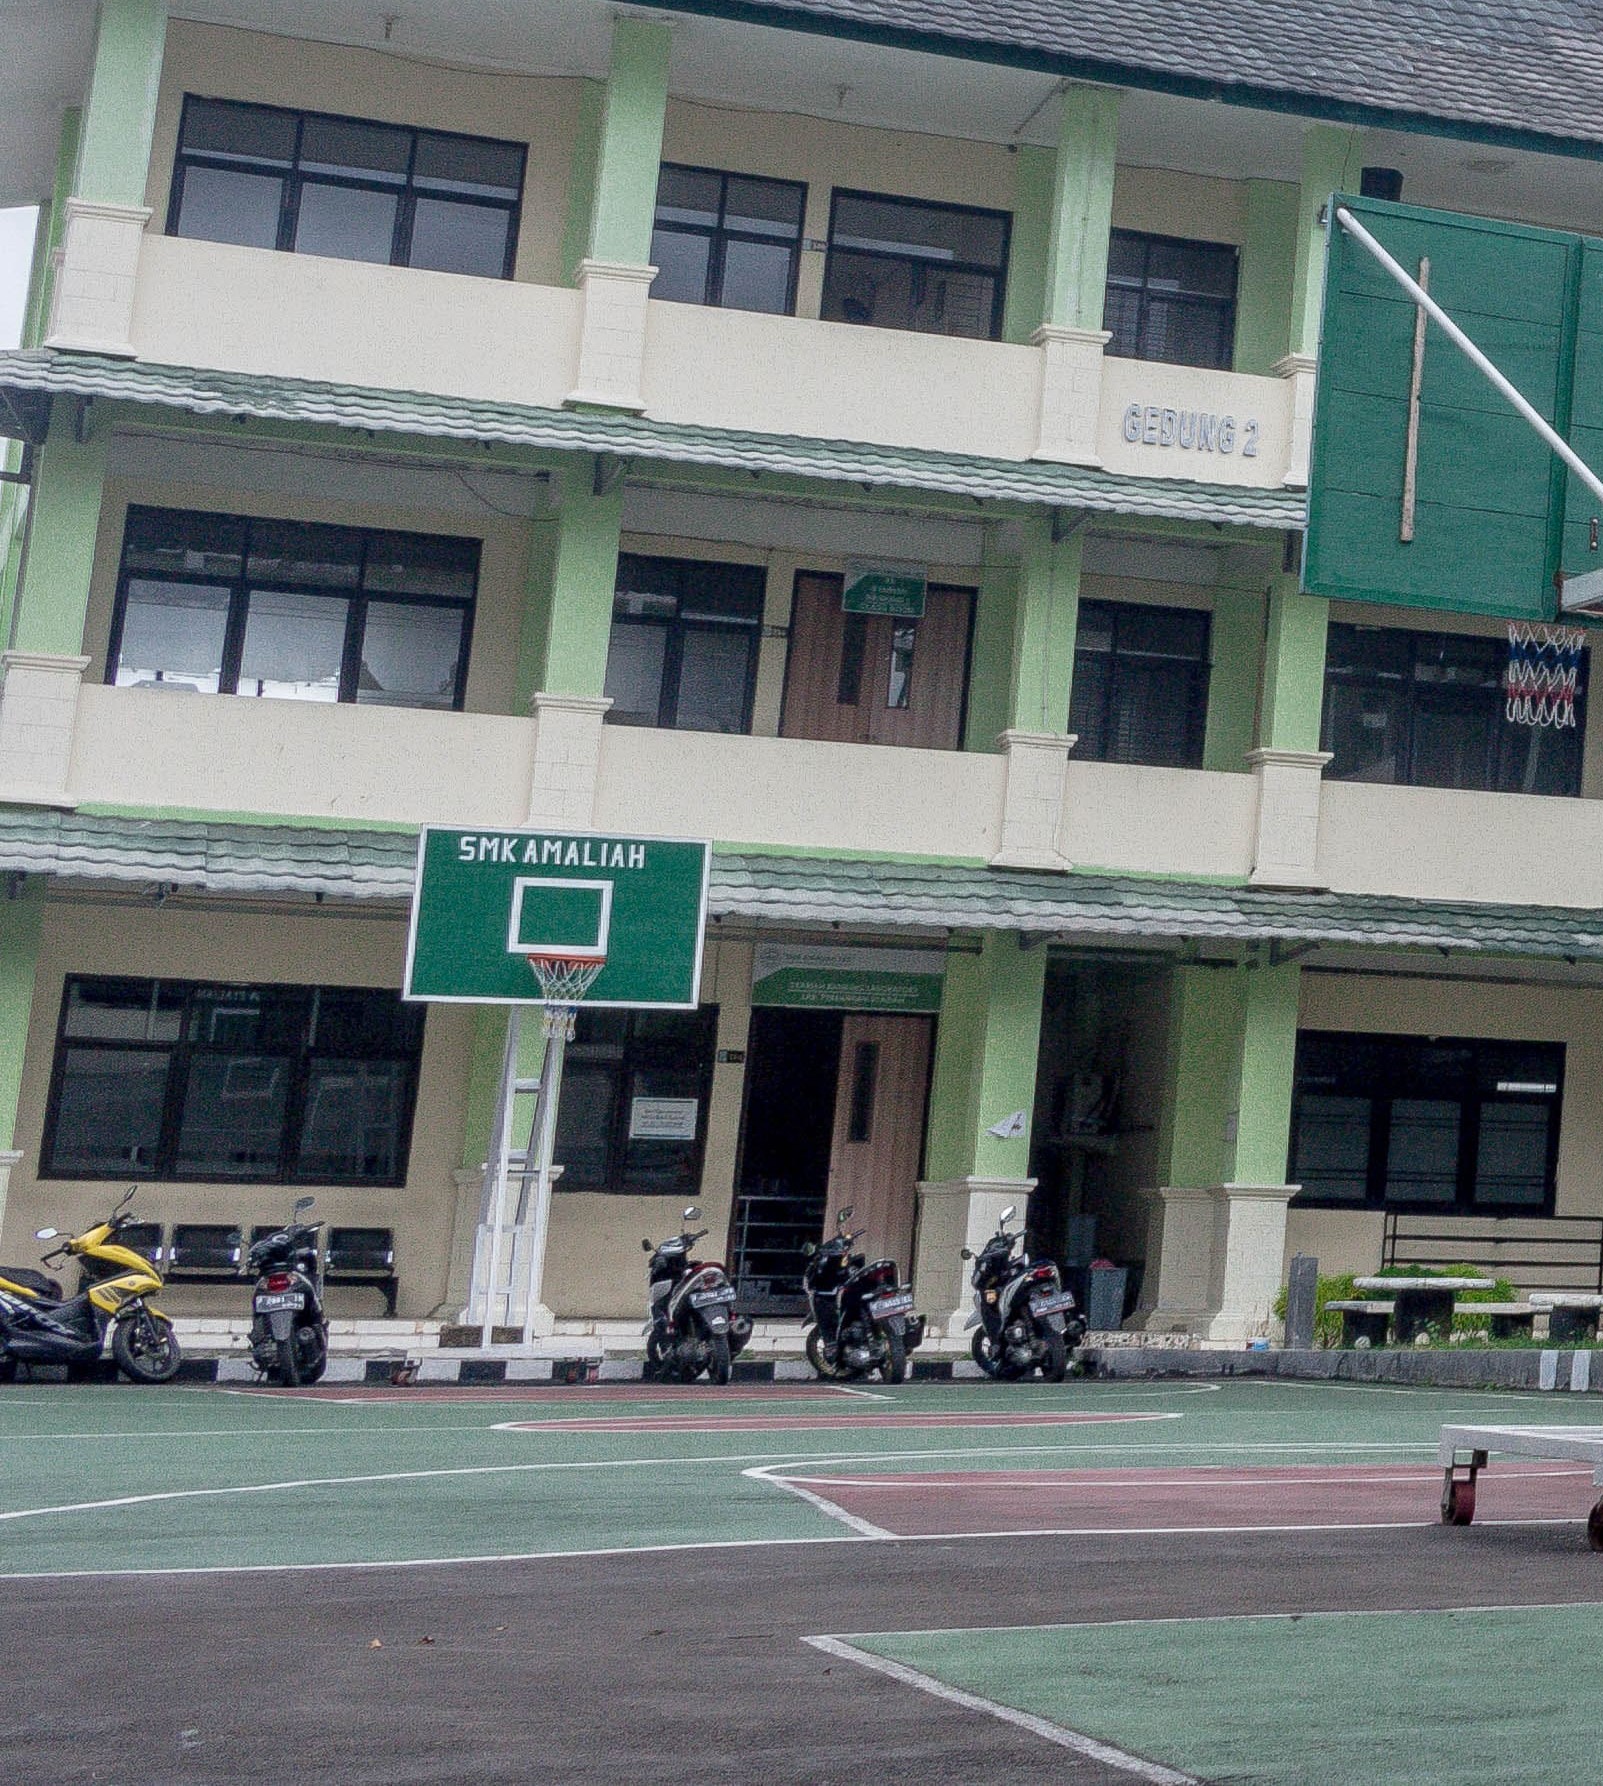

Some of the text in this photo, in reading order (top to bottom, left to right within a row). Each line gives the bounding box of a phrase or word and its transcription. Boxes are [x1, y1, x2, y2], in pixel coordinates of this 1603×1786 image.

[1124, 403, 1259, 457] GEDUNG 2
[458, 836, 646, 869] SMK AMALIAH
